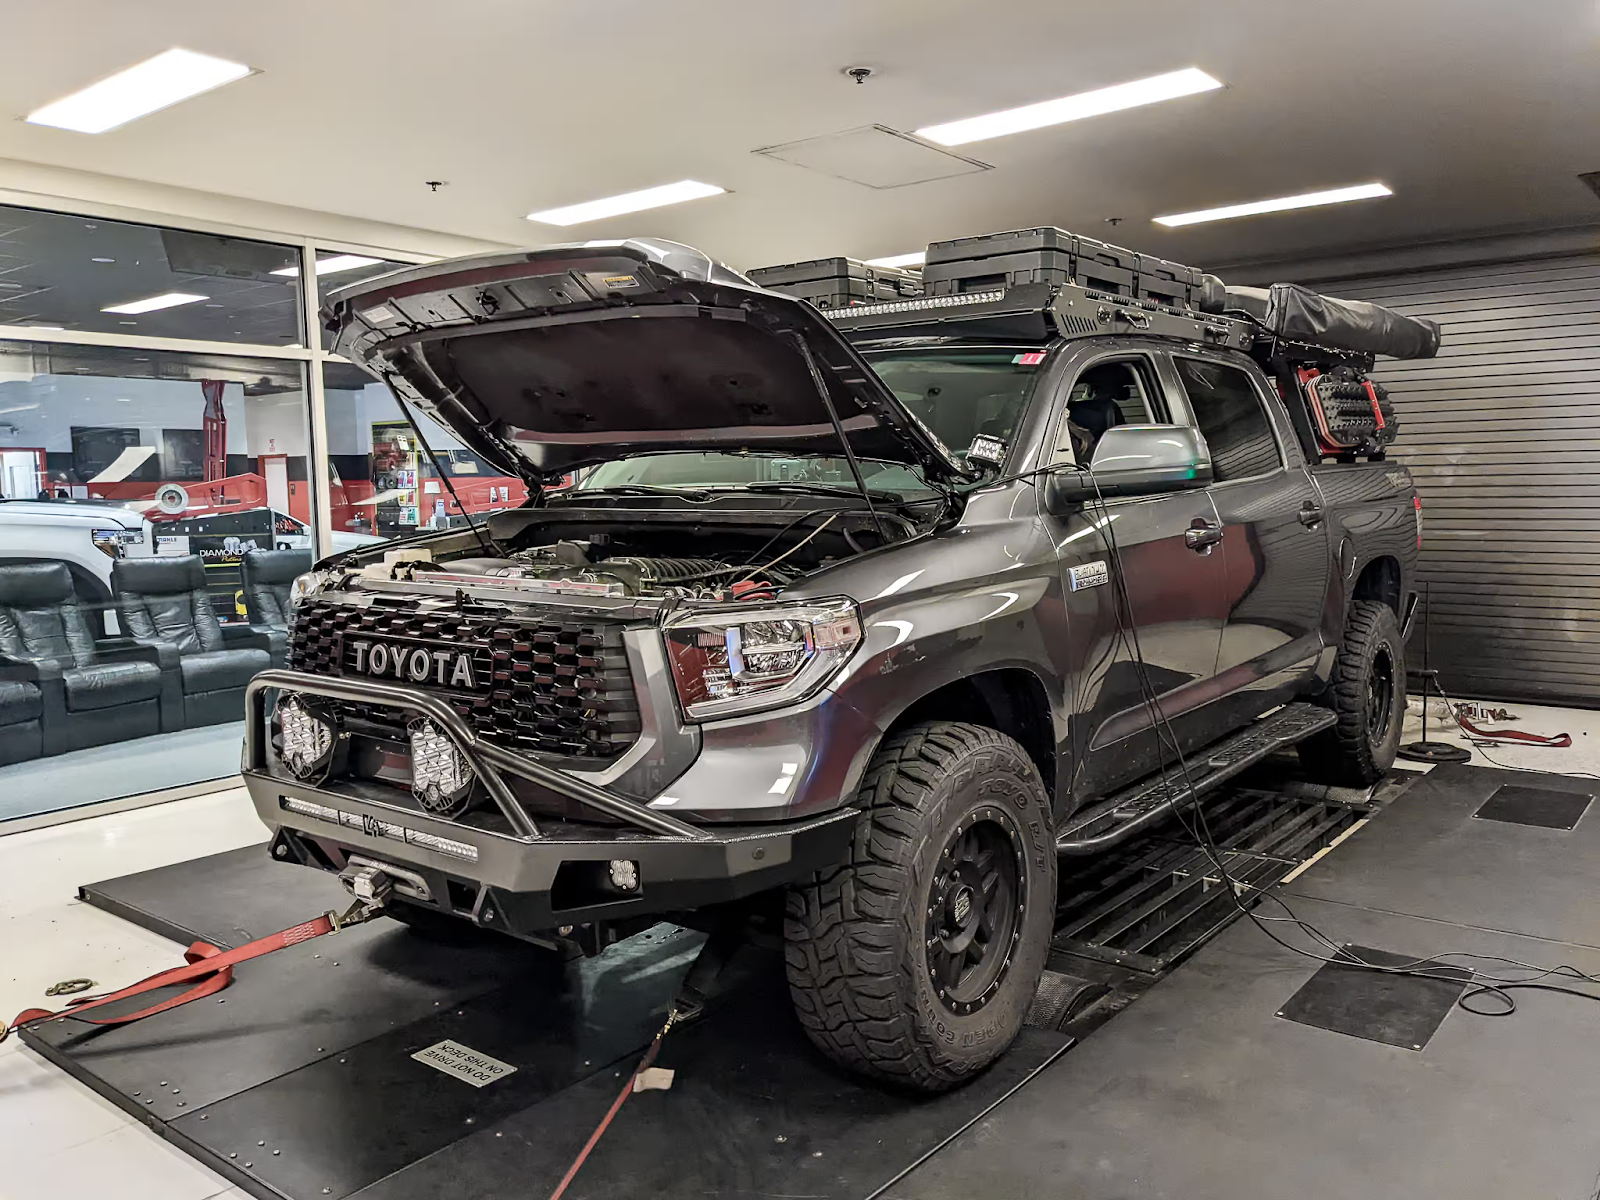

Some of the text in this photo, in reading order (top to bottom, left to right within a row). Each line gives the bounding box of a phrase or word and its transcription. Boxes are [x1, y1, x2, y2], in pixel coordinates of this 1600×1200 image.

[199, 548, 244, 557] DIAMOND
[353, 641, 474, 688] TOYOTA
[978, 778, 1027, 809] TOYO
[962, 1012, 1008, 1048] OPEN
[424, 1050, 491, 1081] DO NOT DRIVE
[438, 1044, 504, 1074] ON THIS DECK
